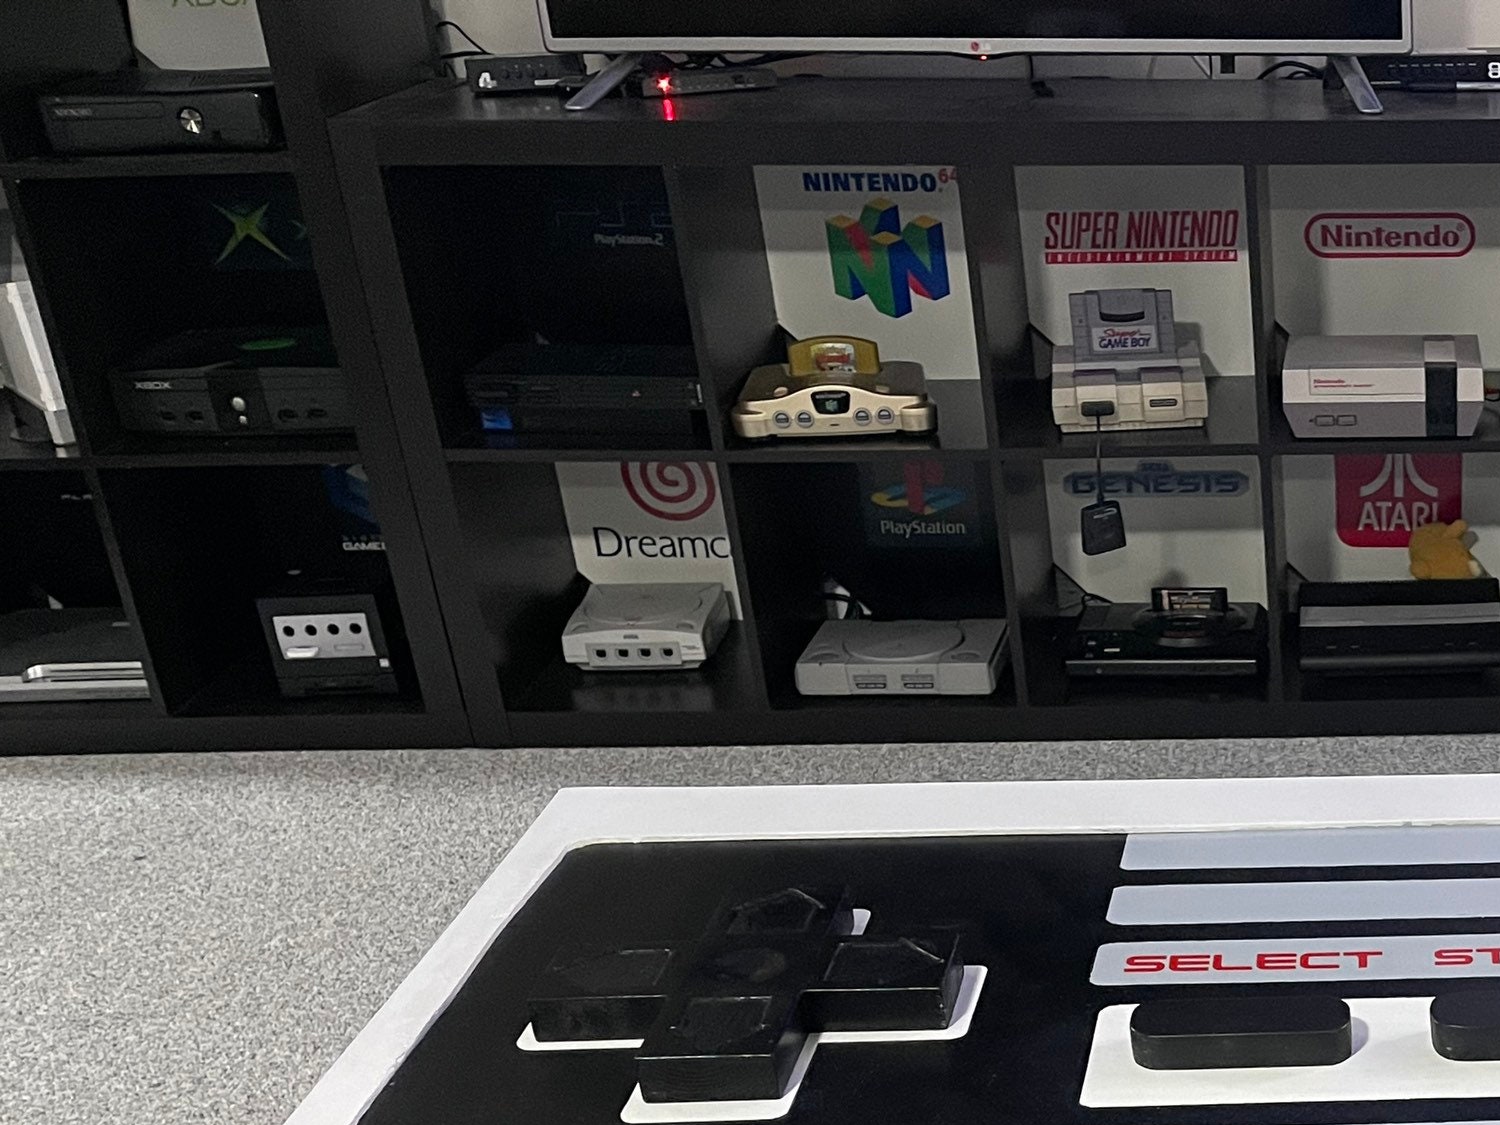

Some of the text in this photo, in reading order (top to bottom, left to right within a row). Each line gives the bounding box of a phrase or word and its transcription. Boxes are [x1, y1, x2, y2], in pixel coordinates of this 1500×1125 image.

[802, 172, 937, 193] NINTENDO
[1044, 209, 1239, 250] SUPER NINTENDO
[1099, 336, 1152, 349] GAME BOY
[1072, 473, 1240, 494] GENESIS
[881, 520, 966, 539] PlayStation
[1124, 951, 1383, 973] SELECT
